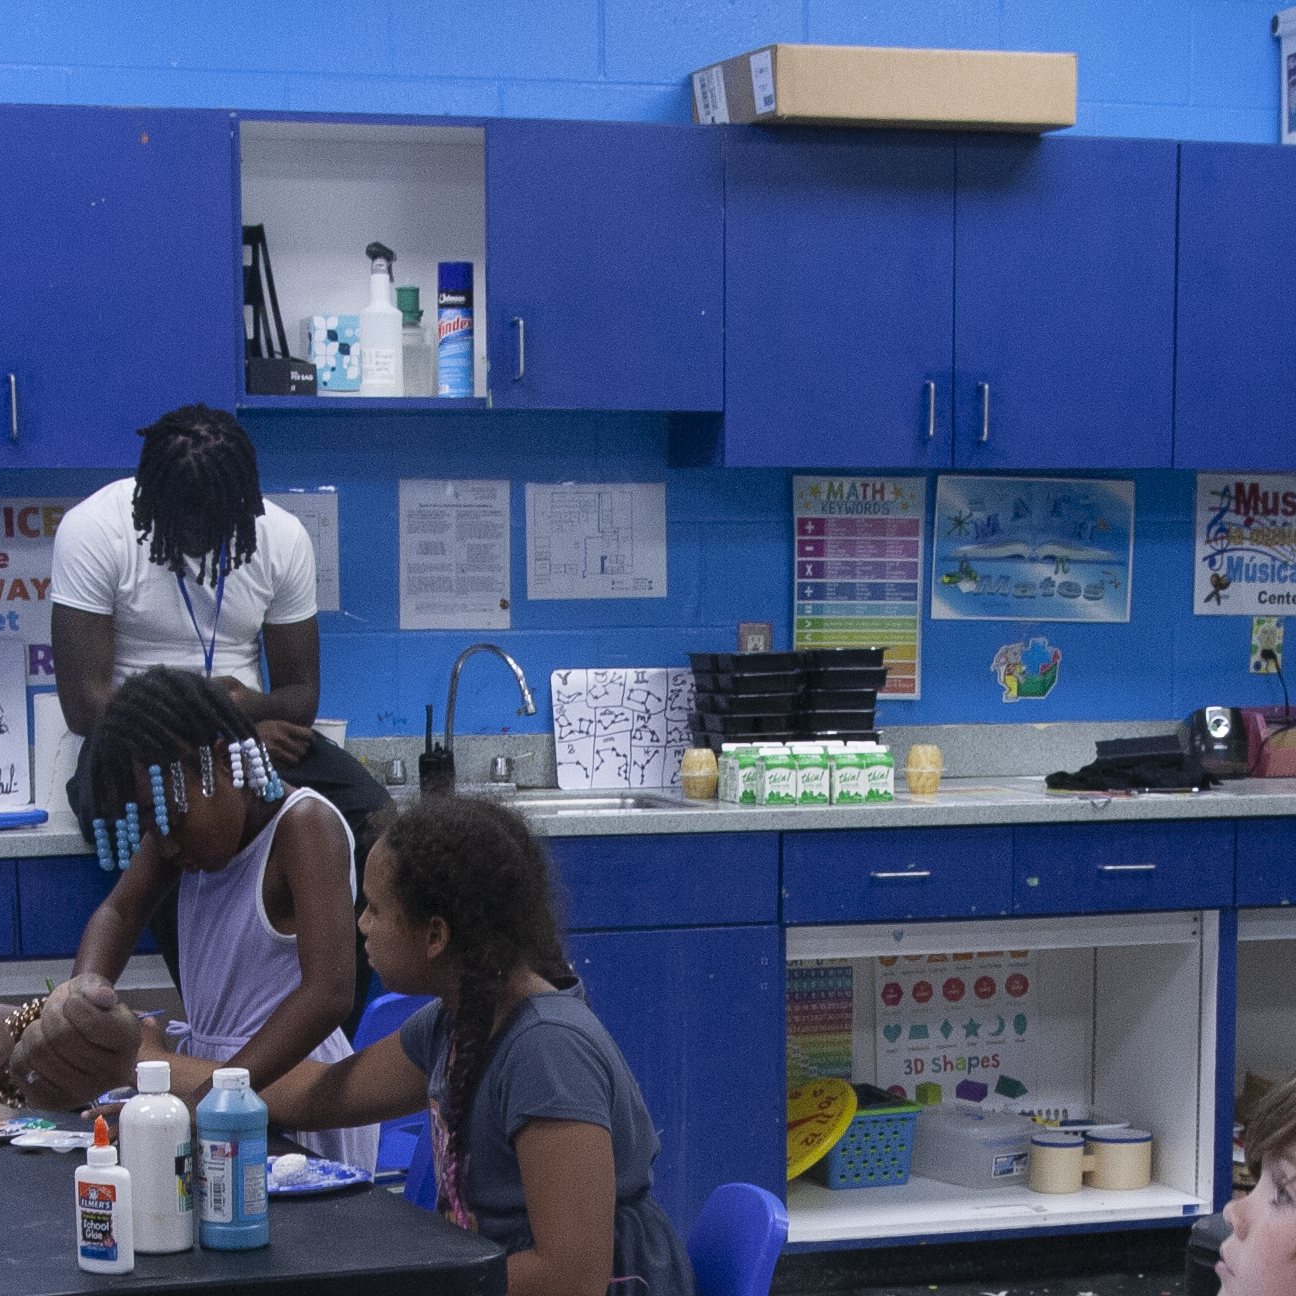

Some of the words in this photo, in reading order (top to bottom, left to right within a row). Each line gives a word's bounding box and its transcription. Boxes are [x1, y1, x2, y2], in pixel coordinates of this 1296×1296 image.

[826, 481, 886, 501] MATH
[820, 501, 891, 516] KEYWORDS
[903, 1057, 925, 1076] 3D
[83, 1219, 110, 1232] School
[85, 1230, 103, 1240] Glue
